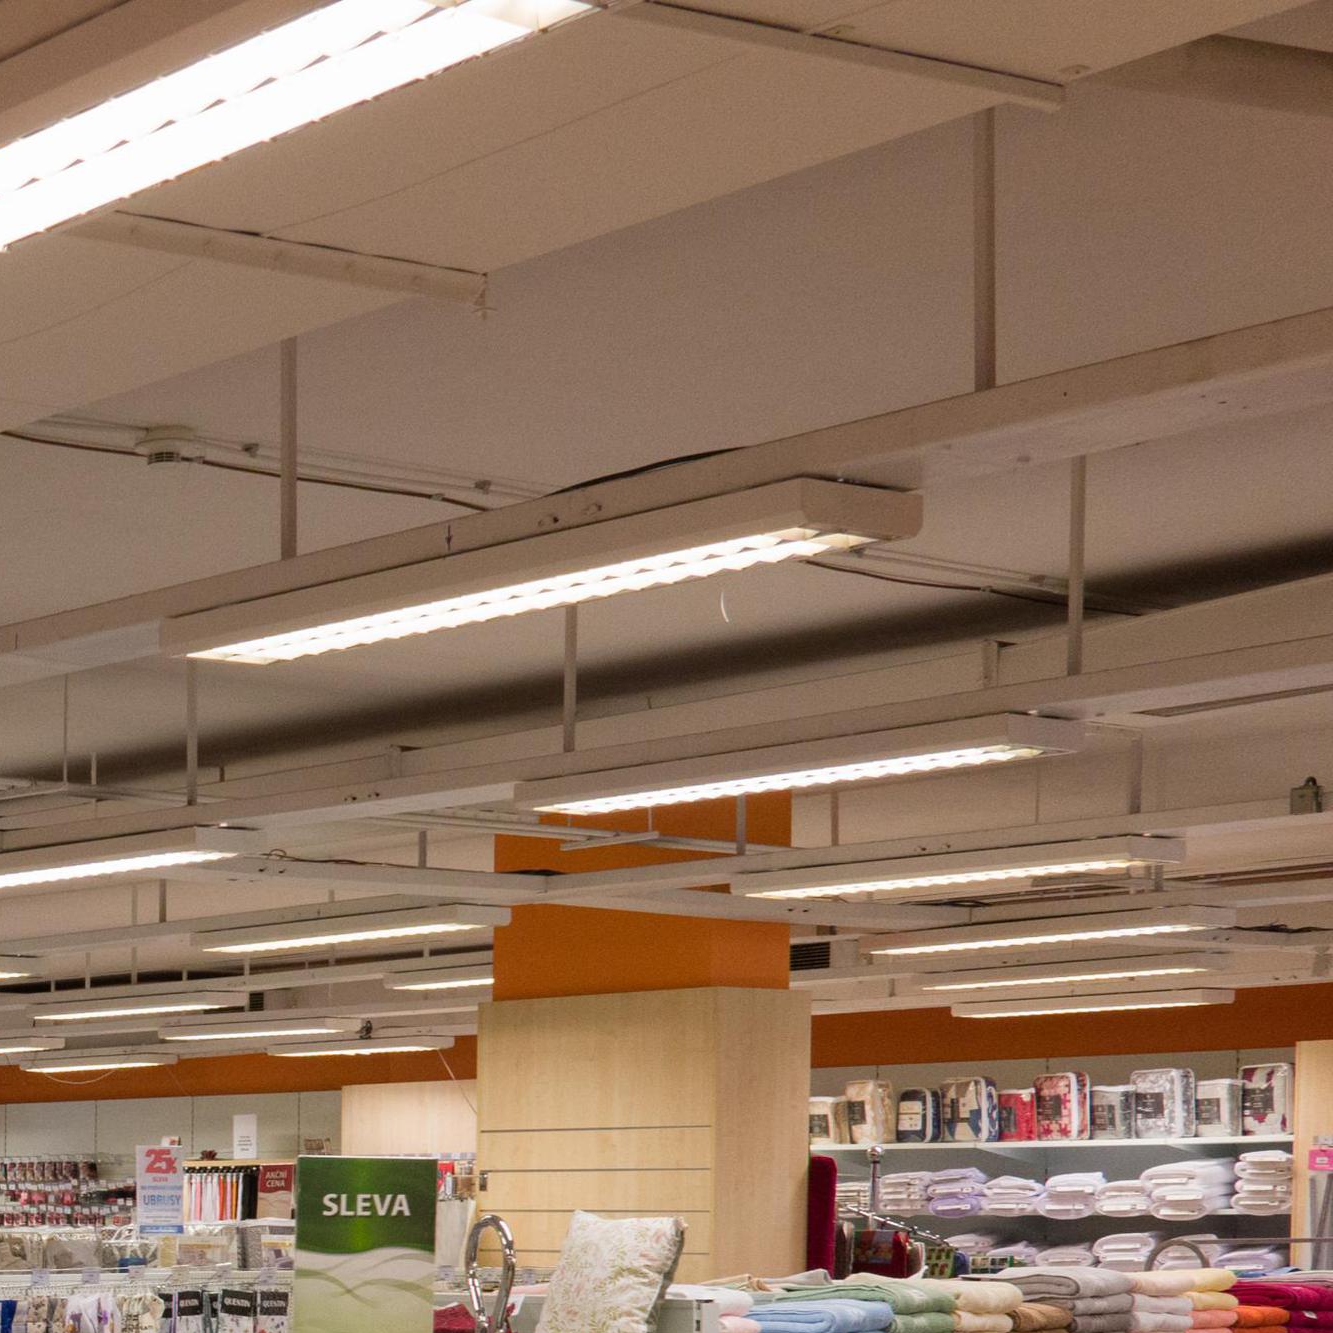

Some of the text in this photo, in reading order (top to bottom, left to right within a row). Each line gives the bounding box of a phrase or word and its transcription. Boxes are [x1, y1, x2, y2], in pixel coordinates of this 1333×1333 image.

[266, 1179, 285, 1188] CENA
[143, 1195, 181, 1206] UBRUSY
[323, 1193, 411, 1216] SLEVA
